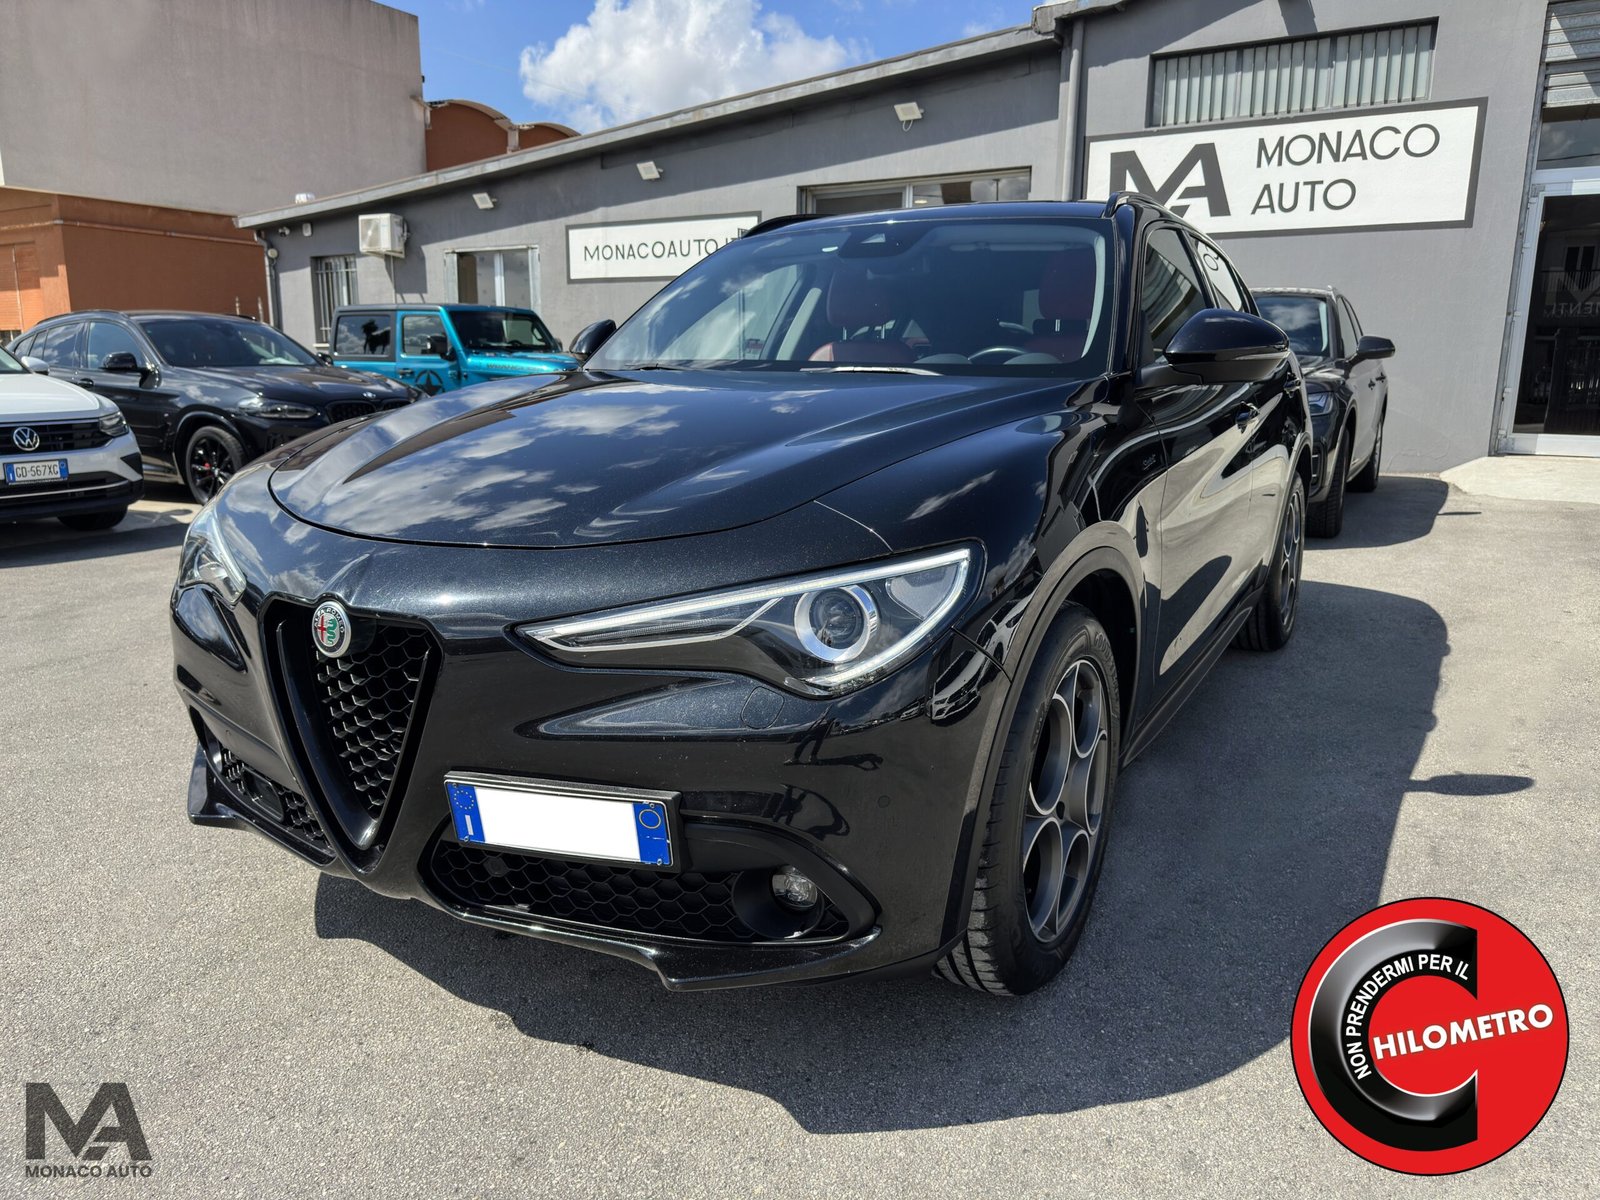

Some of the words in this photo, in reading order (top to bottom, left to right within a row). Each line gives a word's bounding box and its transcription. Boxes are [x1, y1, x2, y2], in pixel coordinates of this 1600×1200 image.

[1256, 123, 1441, 169] MONACO
[1250, 178, 1357, 215] AUTO
[326, 607, 345, 633] ROMEO
